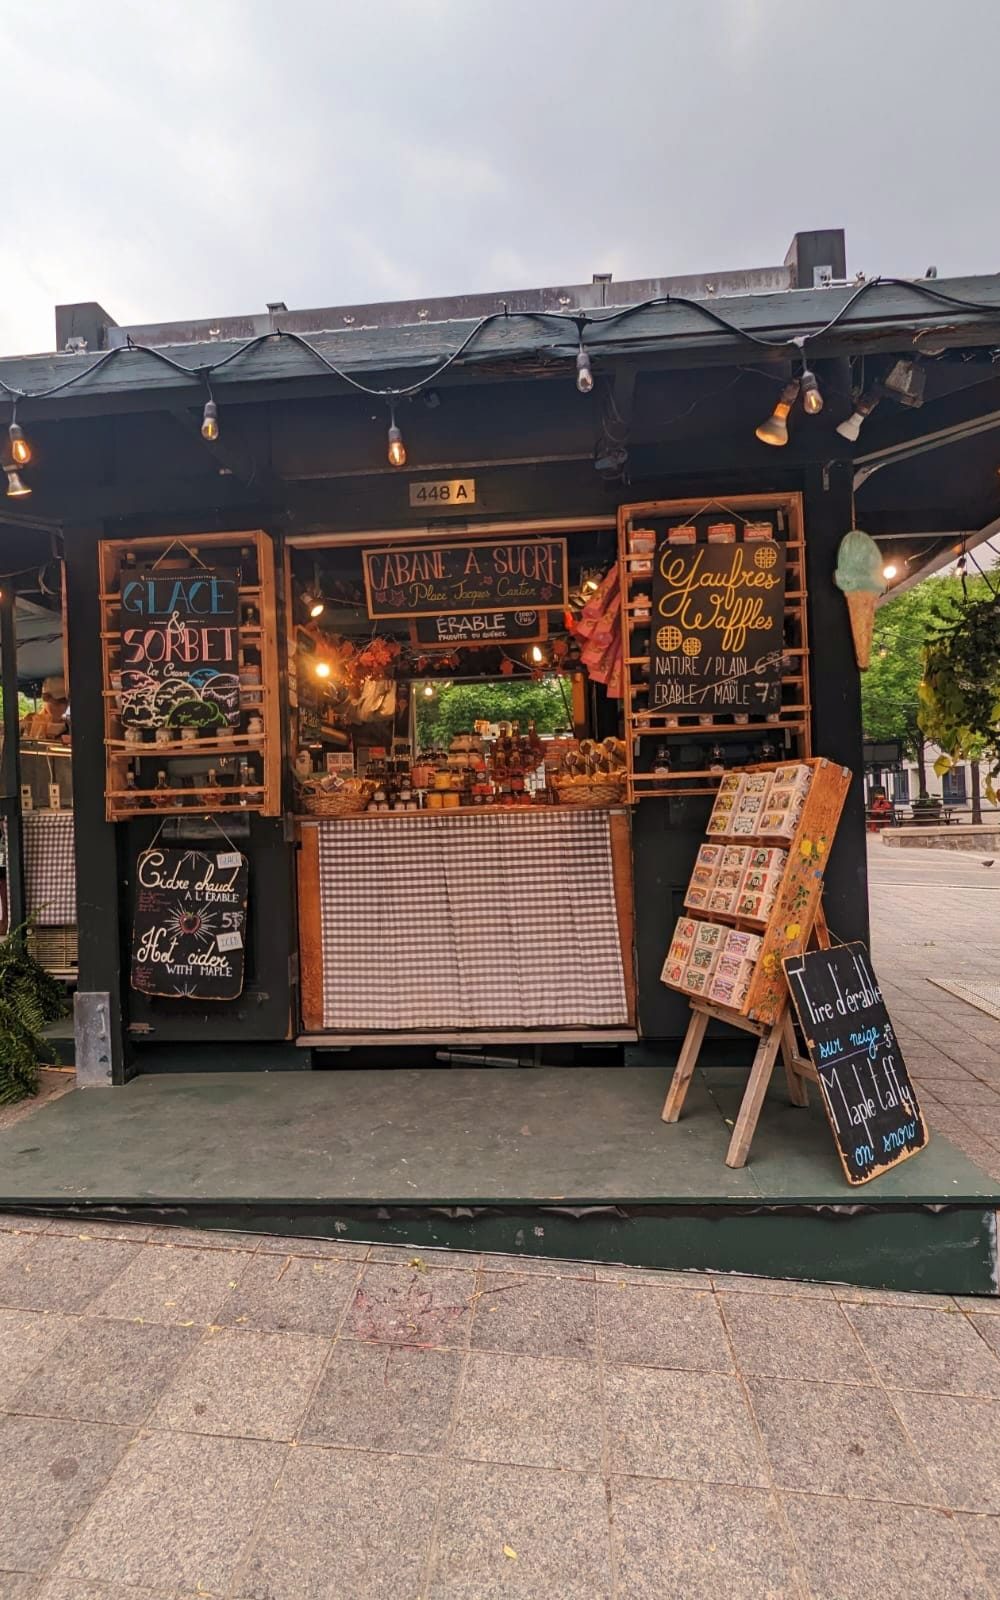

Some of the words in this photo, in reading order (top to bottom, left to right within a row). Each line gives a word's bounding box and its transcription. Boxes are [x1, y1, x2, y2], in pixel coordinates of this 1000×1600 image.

[416, 487, 450, 501] 448
[456, 485, 468, 499] A
[368, 551, 452, 592] CABANE
[493, 544, 562, 589] SUCRE
[659, 547, 781, 617] Gaufres
[122, 579, 235, 615] GLACE
[408, 582, 447, 607] Place
[167, 610, 187, 645] &
[681, 594, 773, 653] Waffles
[123, 627, 237, 663] SORBET
[655, 655, 700, 676] NATURE
[714, 656, 747, 676] PLAIN
[713, 684, 750, 705] MAPLE
[138, 851, 189, 889] Cidre
[194, 863, 240, 893] chaud
[136, 926, 178, 964] Hot
[188, 941, 229, 967] cider
[166, 964, 193, 976] WITH
[200, 965, 233, 977] MAPLE
[788, 967, 834, 1024] Tire
[818, 1040, 843, 1058] sur
[849, 1024, 880, 1059] neige
[820, 1067, 876, 1149] Maple
[855, 1143, 873, 1166] on
[883, 1121, 916, 1152] snow
